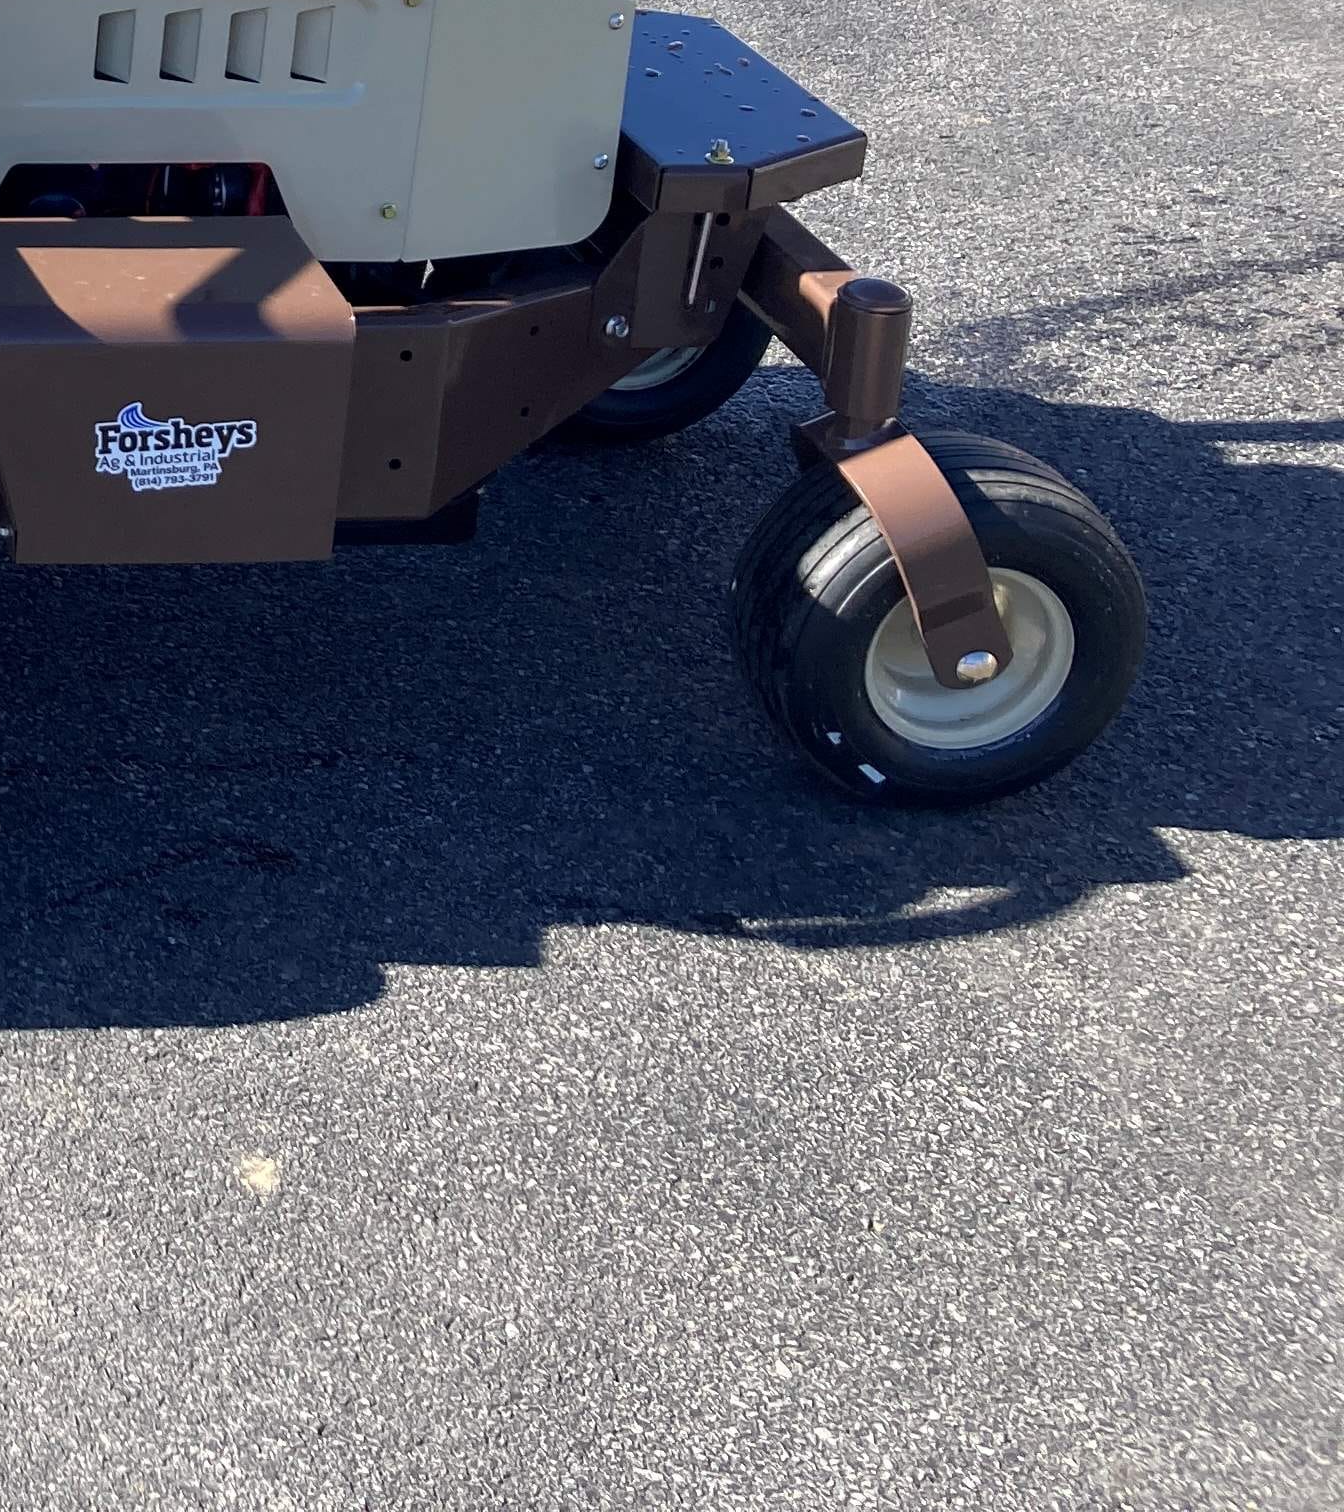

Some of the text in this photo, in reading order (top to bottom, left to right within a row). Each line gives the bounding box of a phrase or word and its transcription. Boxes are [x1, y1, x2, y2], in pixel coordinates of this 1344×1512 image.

[98, 421, 254, 455] Forsheys
[99, 449, 215, 470] Ag & Industrial
[203, 462, 219, 471] PA
[134, 476, 162, 488] (814)
